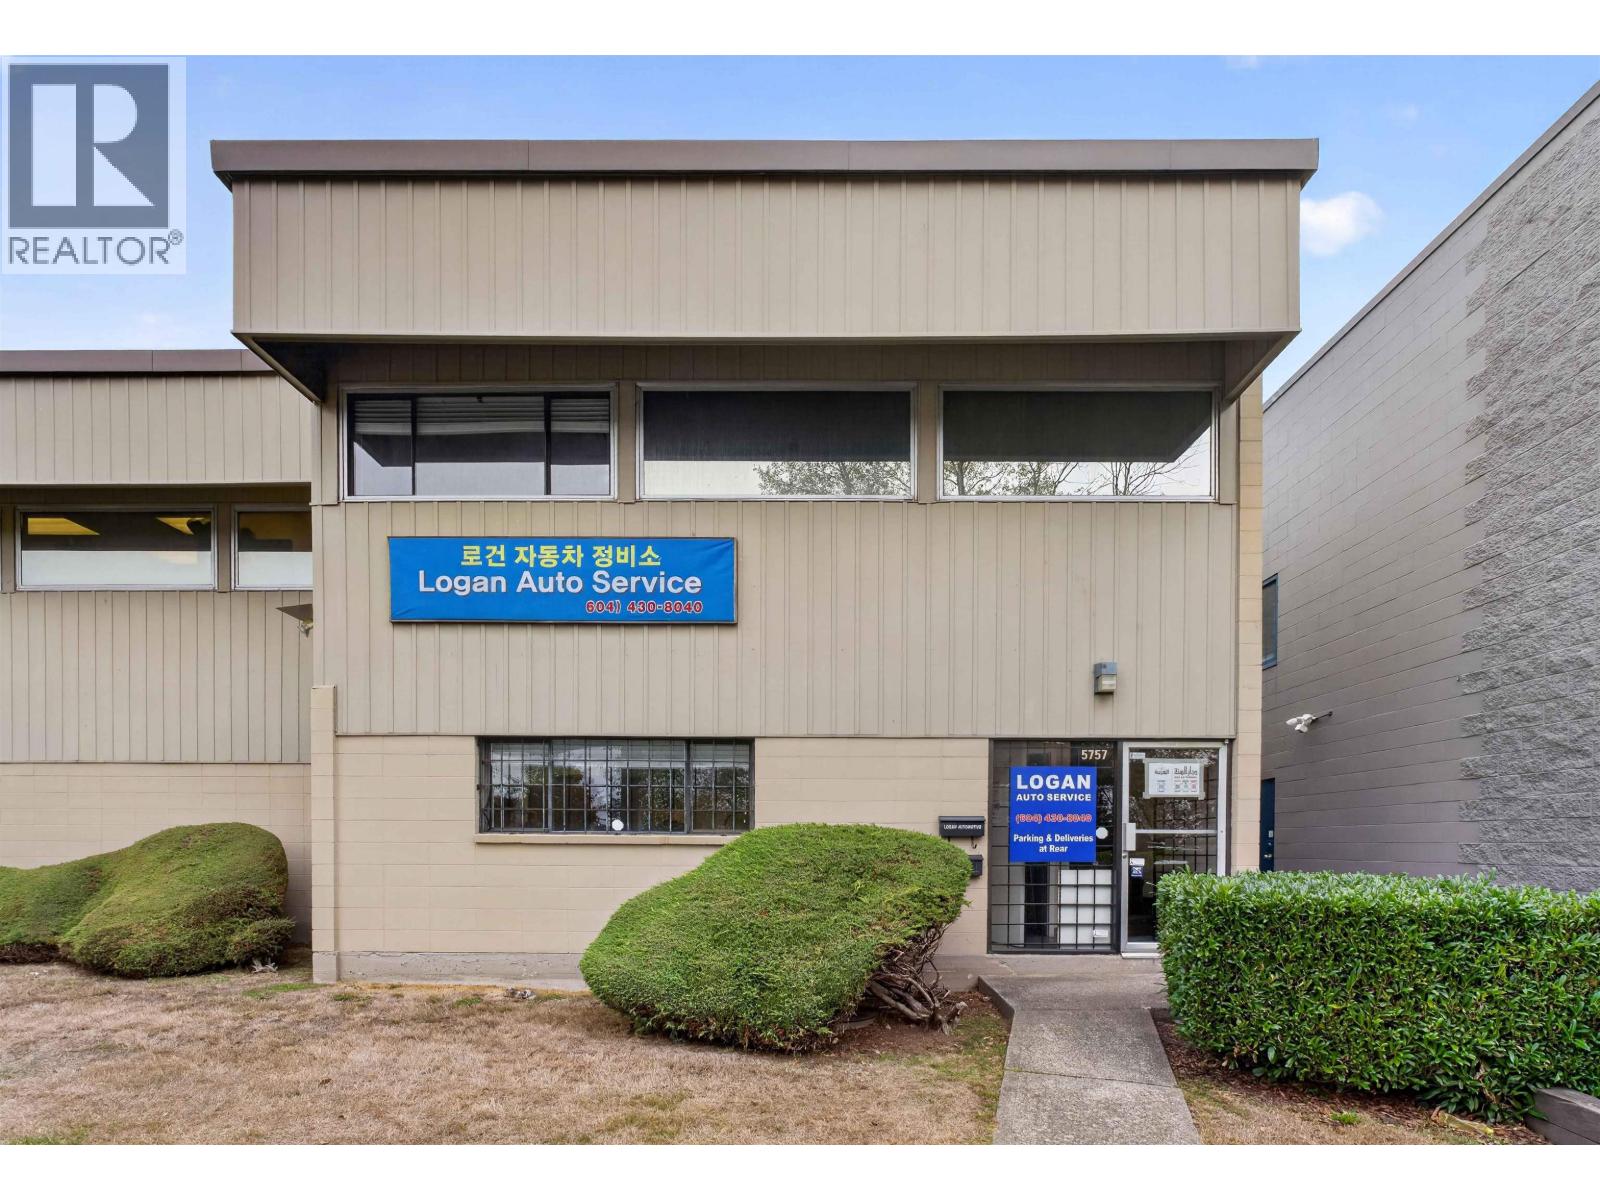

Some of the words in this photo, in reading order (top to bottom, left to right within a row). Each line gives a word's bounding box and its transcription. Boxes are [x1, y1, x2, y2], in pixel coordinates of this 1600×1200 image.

[461, 545, 506, 567] 로건
[514, 545, 584, 568] 자동차
[592, 545, 662, 568] 정비소
[418, 570, 507, 596] Logan
[516, 571, 583, 594] Auto
[592, 570, 702, 594] Service
[585, 600, 622, 614] 604)
[626, 600, 703, 614] 430-8040
[1081, 749, 1108, 760] 5757
[1016, 774, 1092, 790] LOGAN
[1016, 793, 1044, 801] AUTO
[1046, 793, 1092, 801] SERVICE
[1013, 834, 1044, 844] Parking
[1046, 834, 1052, 842] &
[1054, 833, 1094, 843] Deliveries
[1039, 845, 1047, 853] at
[1049, 845, 1069, 853] Rear
